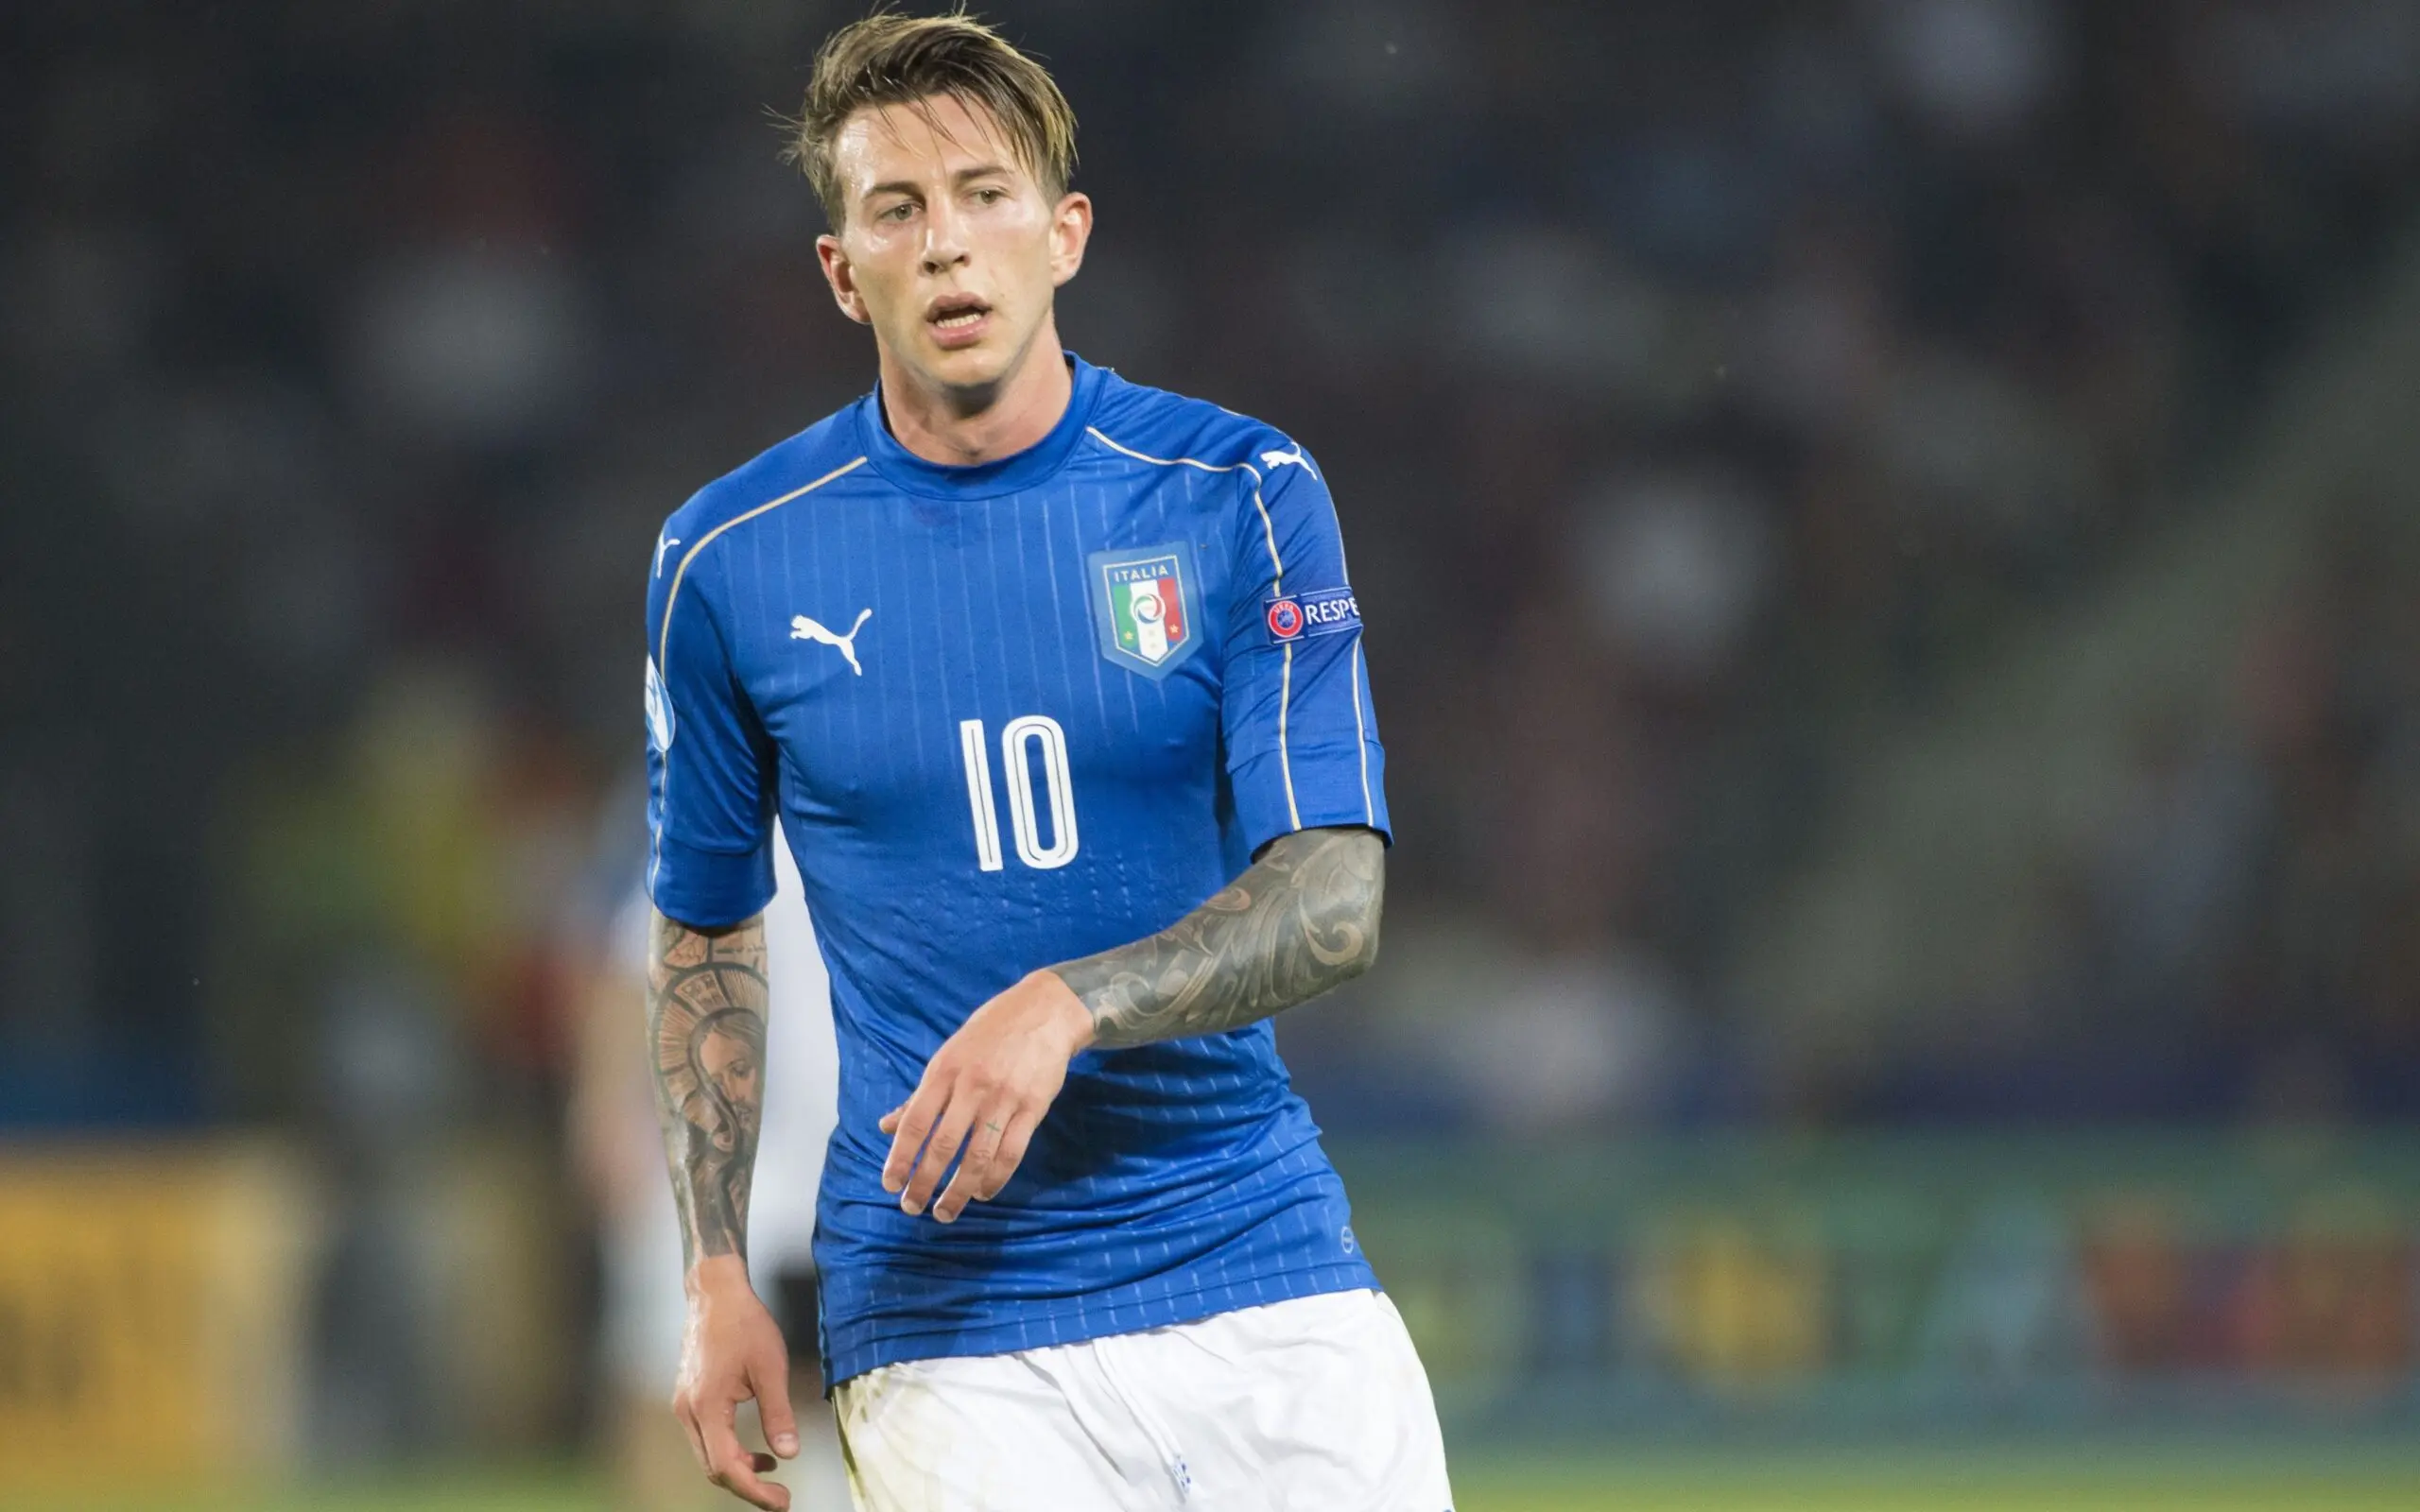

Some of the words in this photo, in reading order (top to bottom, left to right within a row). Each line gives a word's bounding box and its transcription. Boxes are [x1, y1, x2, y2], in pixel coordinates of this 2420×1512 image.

[1114, 565, 1168, 582] ITALIA
[1273, 603, 1294, 614] UEFA
[959, 714, 1079, 872] 10
